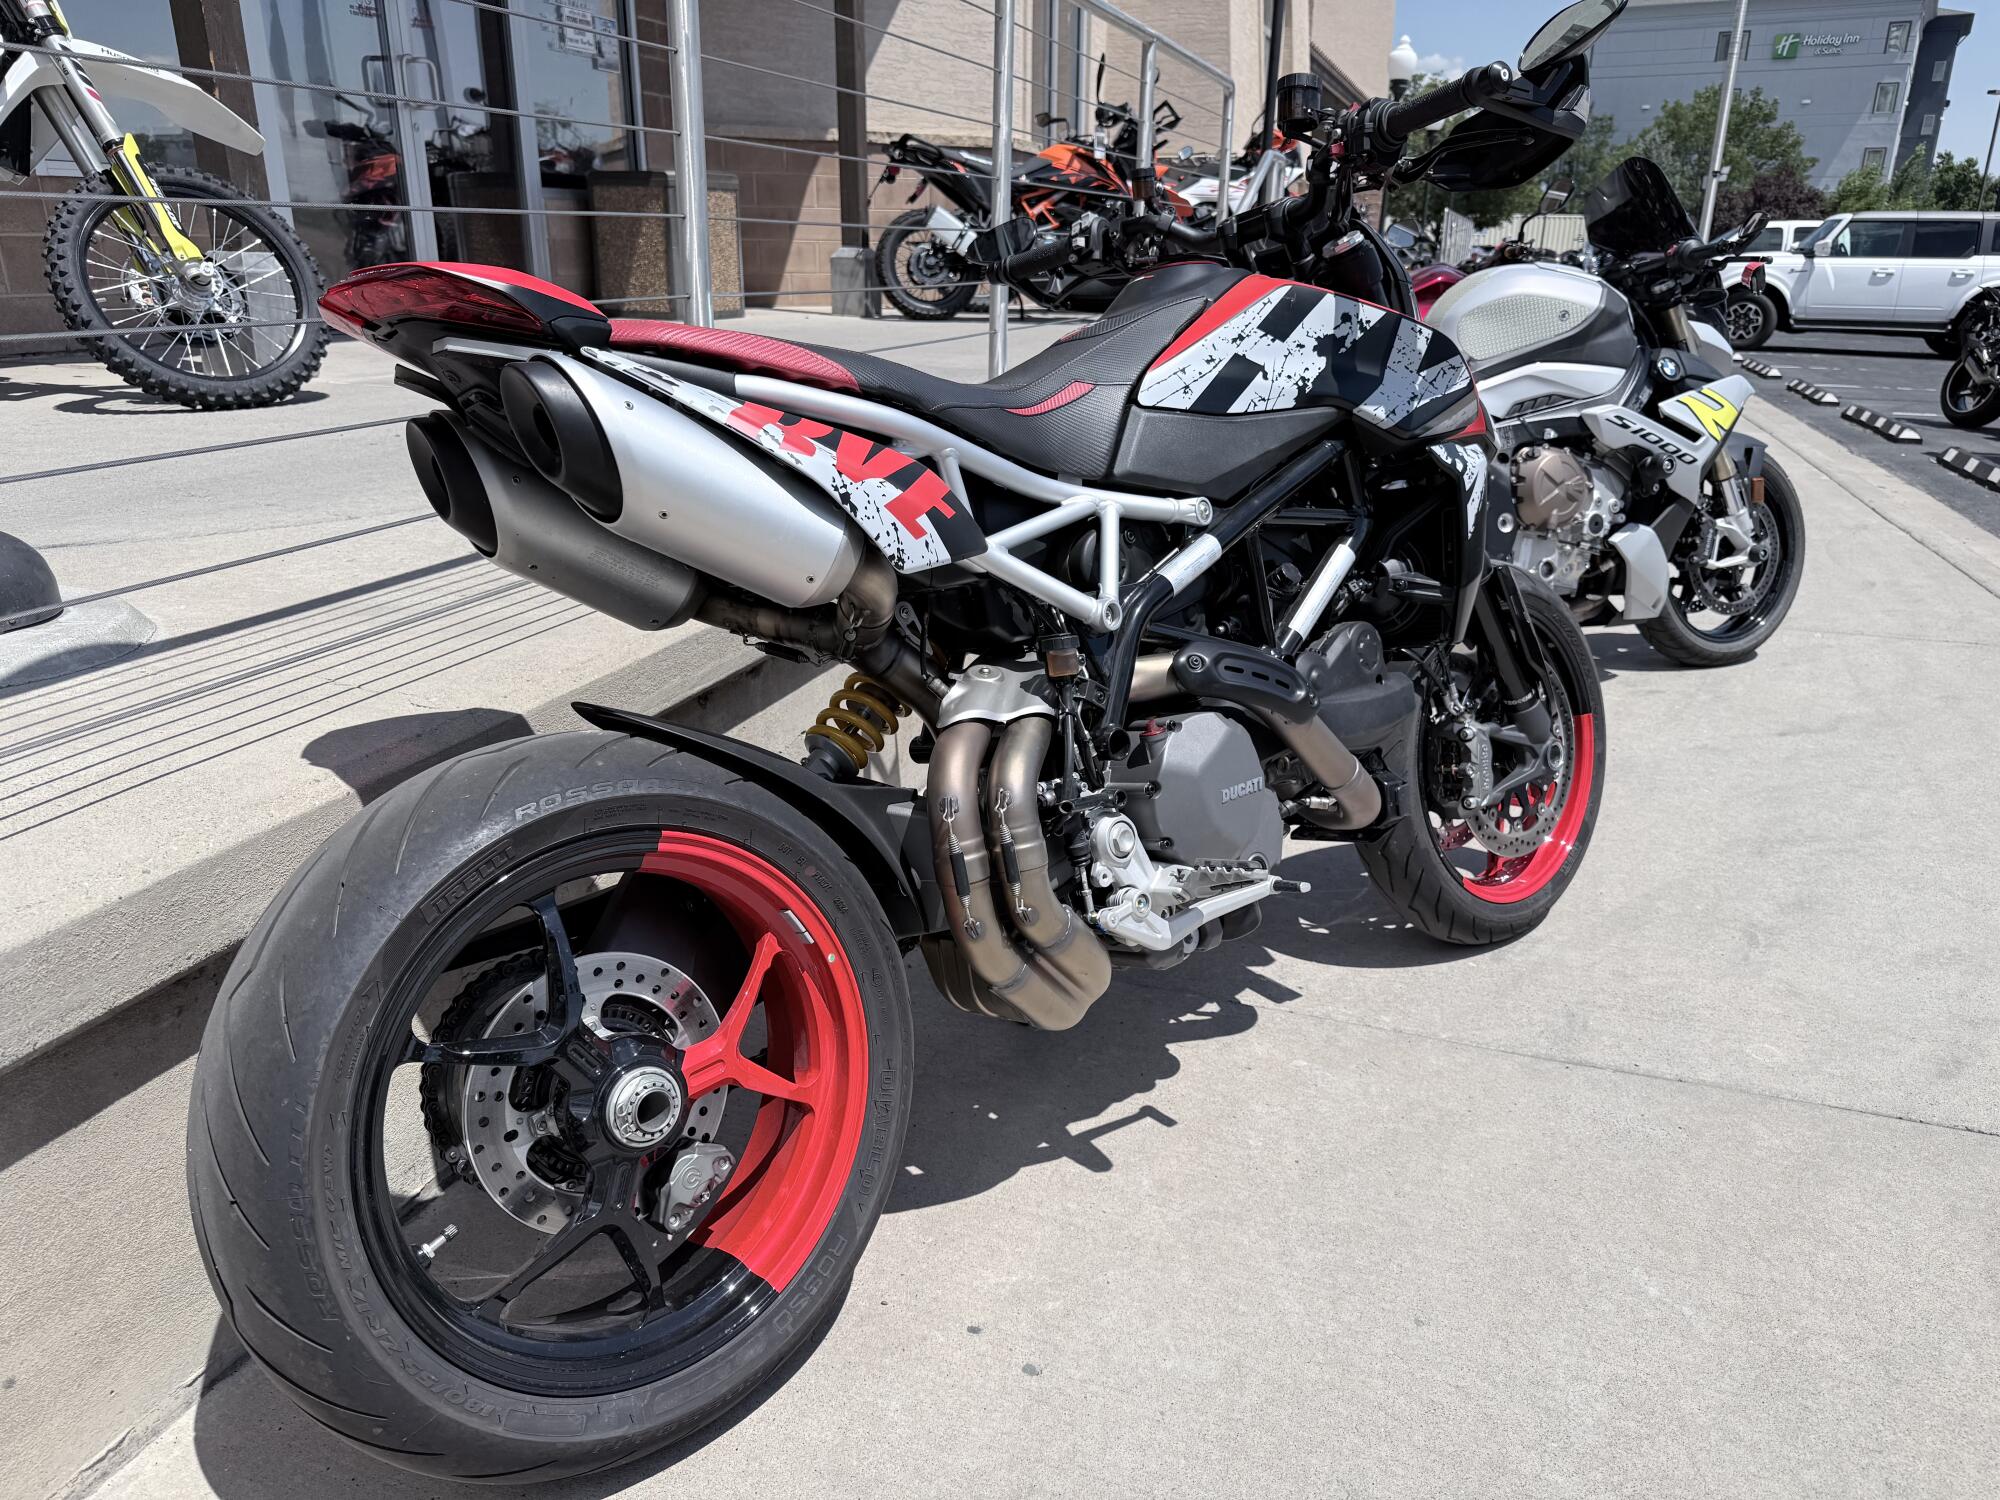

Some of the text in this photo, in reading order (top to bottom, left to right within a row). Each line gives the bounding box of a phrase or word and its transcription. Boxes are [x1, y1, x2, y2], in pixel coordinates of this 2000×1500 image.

[1803, 33, 1860, 46] Holiday Inn
[1605, 415, 1698, 465] S1000
[515, 779, 639, 822] ROSSO
[1221, 776, 1263, 803] DUCATI
[420, 839, 515, 926] PIRELLI
[859, 1069, 897, 1197] DIABLO
[772, 1234, 848, 1334] ROSSO
